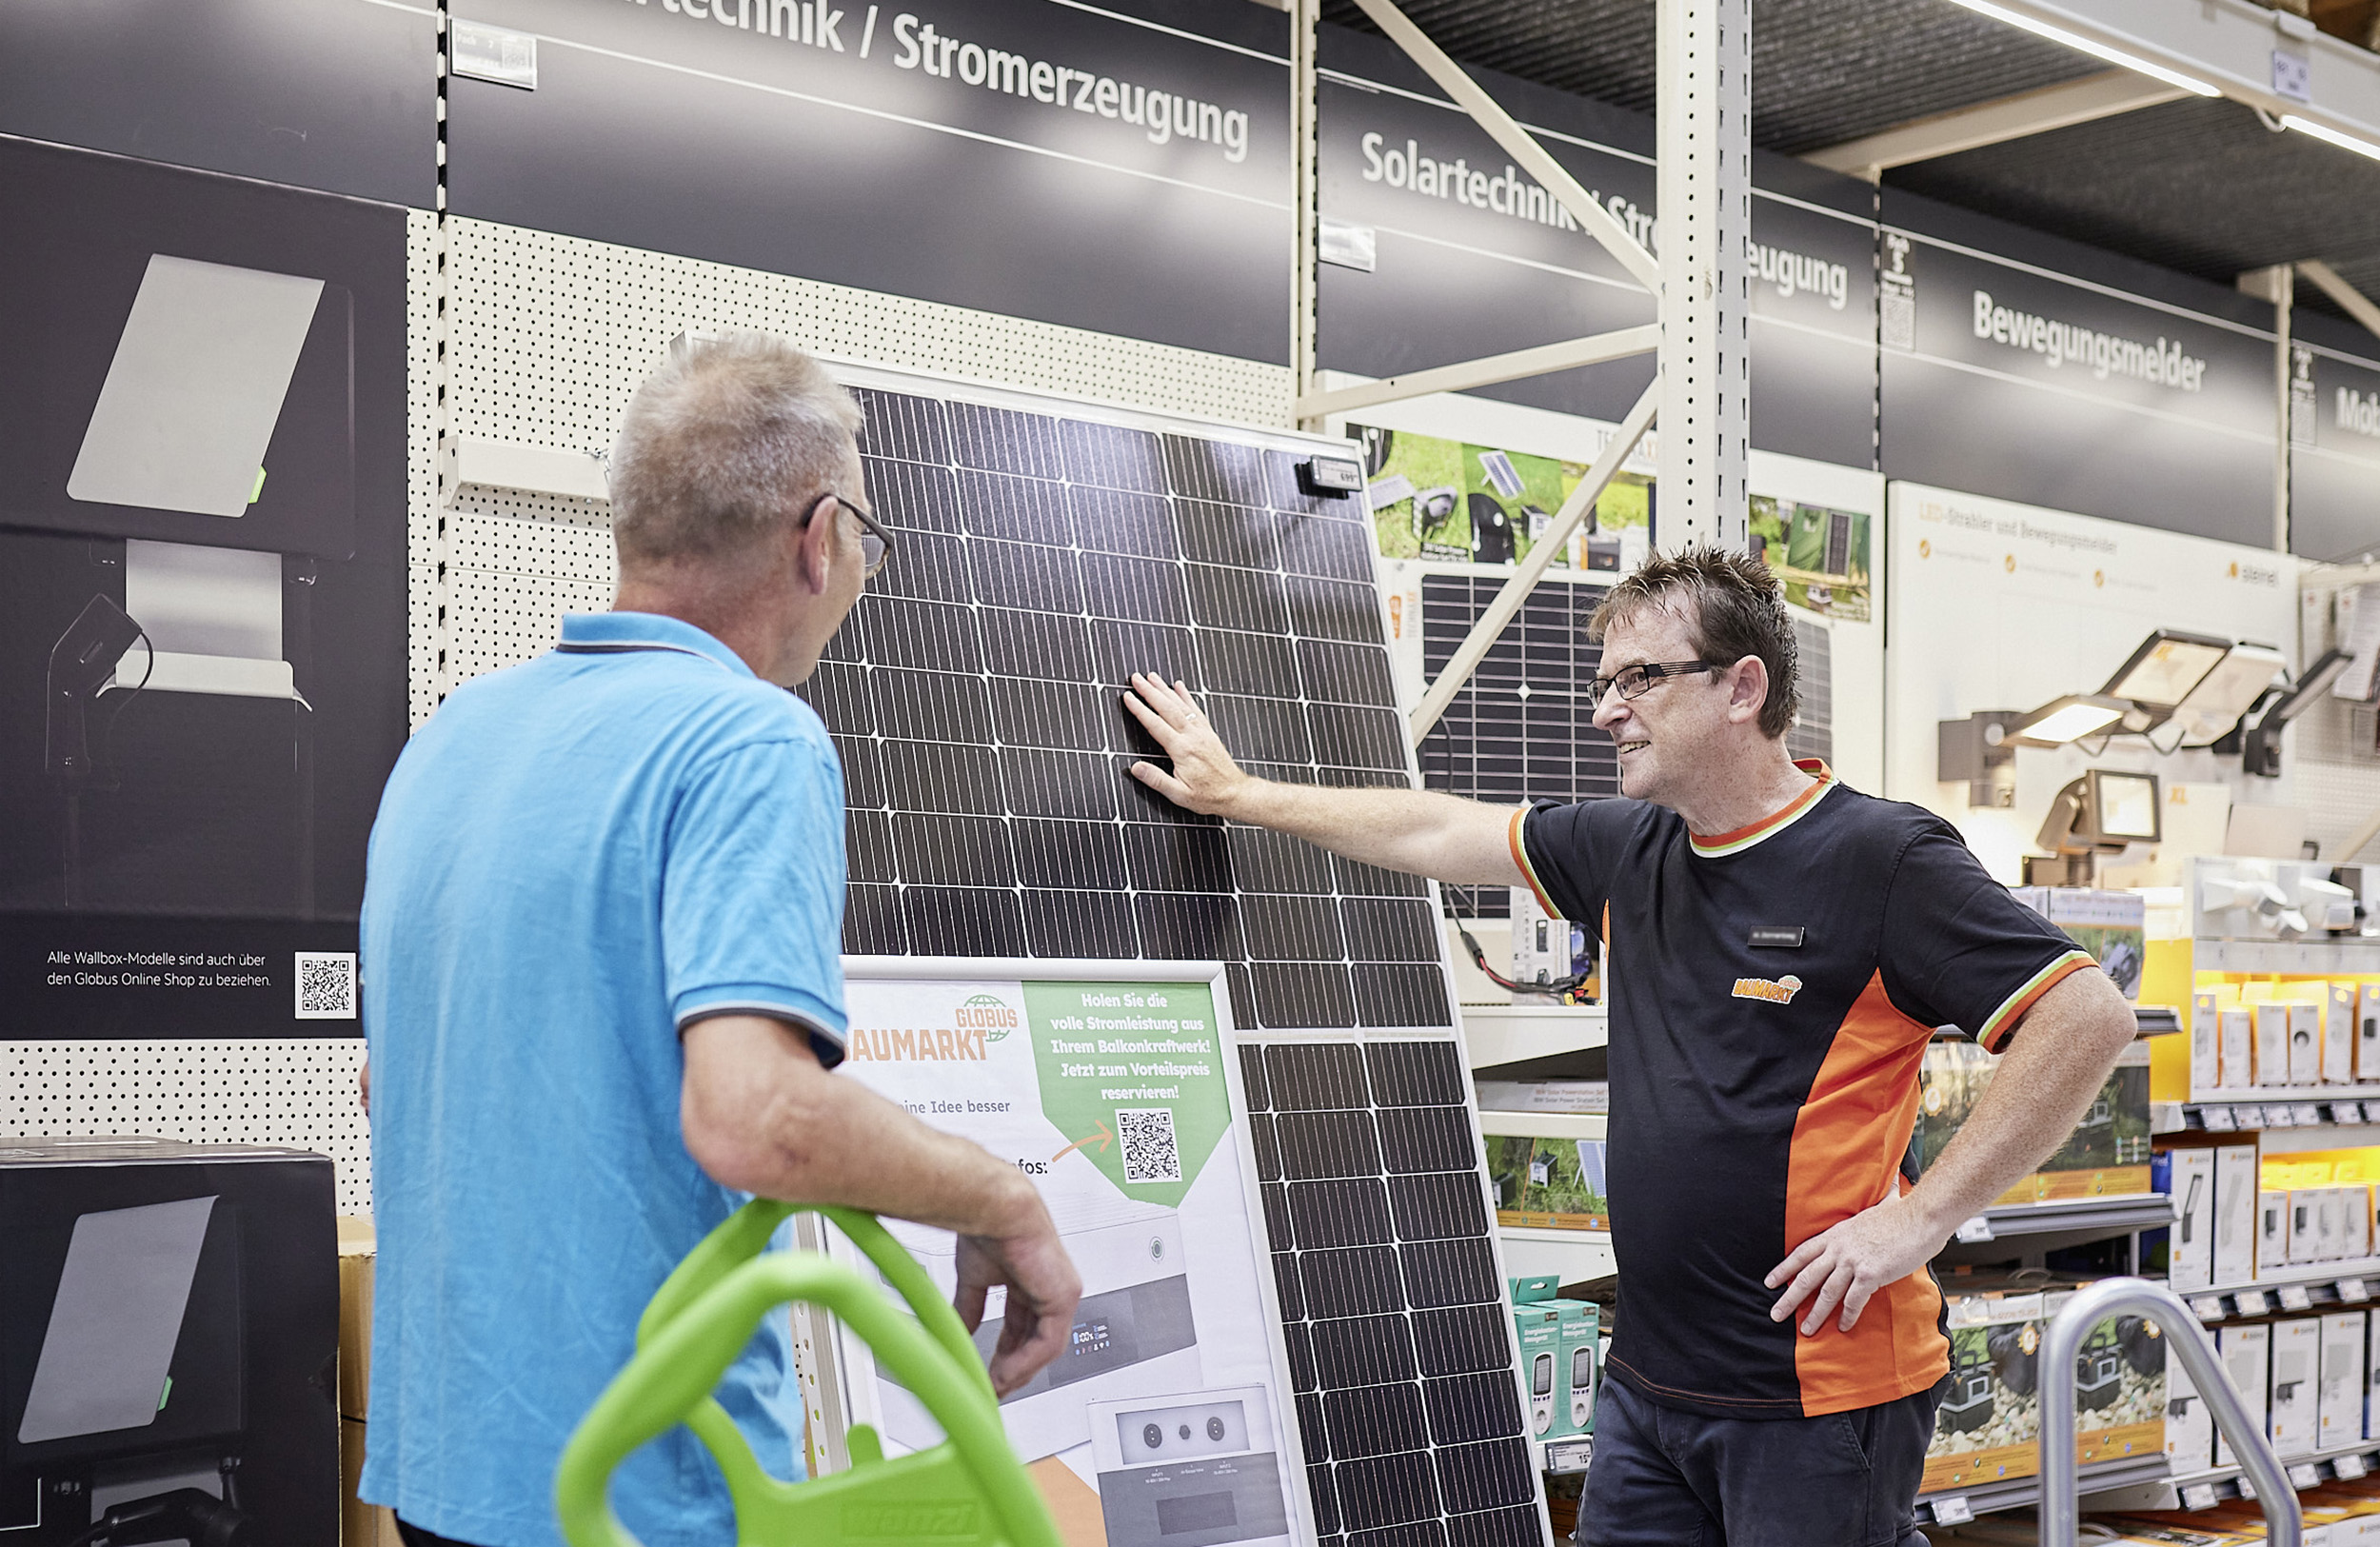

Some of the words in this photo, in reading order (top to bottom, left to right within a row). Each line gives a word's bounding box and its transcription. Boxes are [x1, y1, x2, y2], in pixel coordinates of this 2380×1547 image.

[859, 4, 879, 59] /
[892, 12, 1249, 163] Stromerzeugung
[1973, 289, 2206, 392] Bewegungsmelder
[47, 951, 71, 964] Alle
[73, 951, 176, 965] Wallbox-Modelle
[178, 952, 204, 965] sind
[207, 952, 236, 965] auch
[239, 953, 266, 966] über
[47, 972, 71, 985] den
[74, 972, 119, 985] Globus
[121, 972, 161, 985] Online
[164, 972, 195, 988] Shop
[198, 975, 213, 986] zu
[216, 973, 271, 986] beziehen.
[1081, 993, 1121, 1008] Holen
[1123, 992, 1144, 1007] Sie
[1147, 992, 1168, 1007] die
[1734, 981, 1794, 1002] BAUMARKT
[955, 1008, 1018, 1027] GLOBUS
[1050, 1016, 1083, 1030] volle
[1086, 1015, 1179, 1034] Stromleistung
[1181, 1020, 1204, 1031] aus
[843, 1029, 987, 1061] AUMARKT
[1051, 1040, 1095, 1053] Ihrem
[1098, 1039, 1211, 1053] Balkonkraftwerk!
[1061, 1063, 1095, 1077] Jetzt
[1098, 1066, 1128, 1077] zum
[1129, 1061, 1210, 1080] Vorteilspreis
[1101, 1083, 1180, 1100] reservieren!
[931, 1101, 962, 1114] Idee
[967, 1100, 1010, 1113] besser
